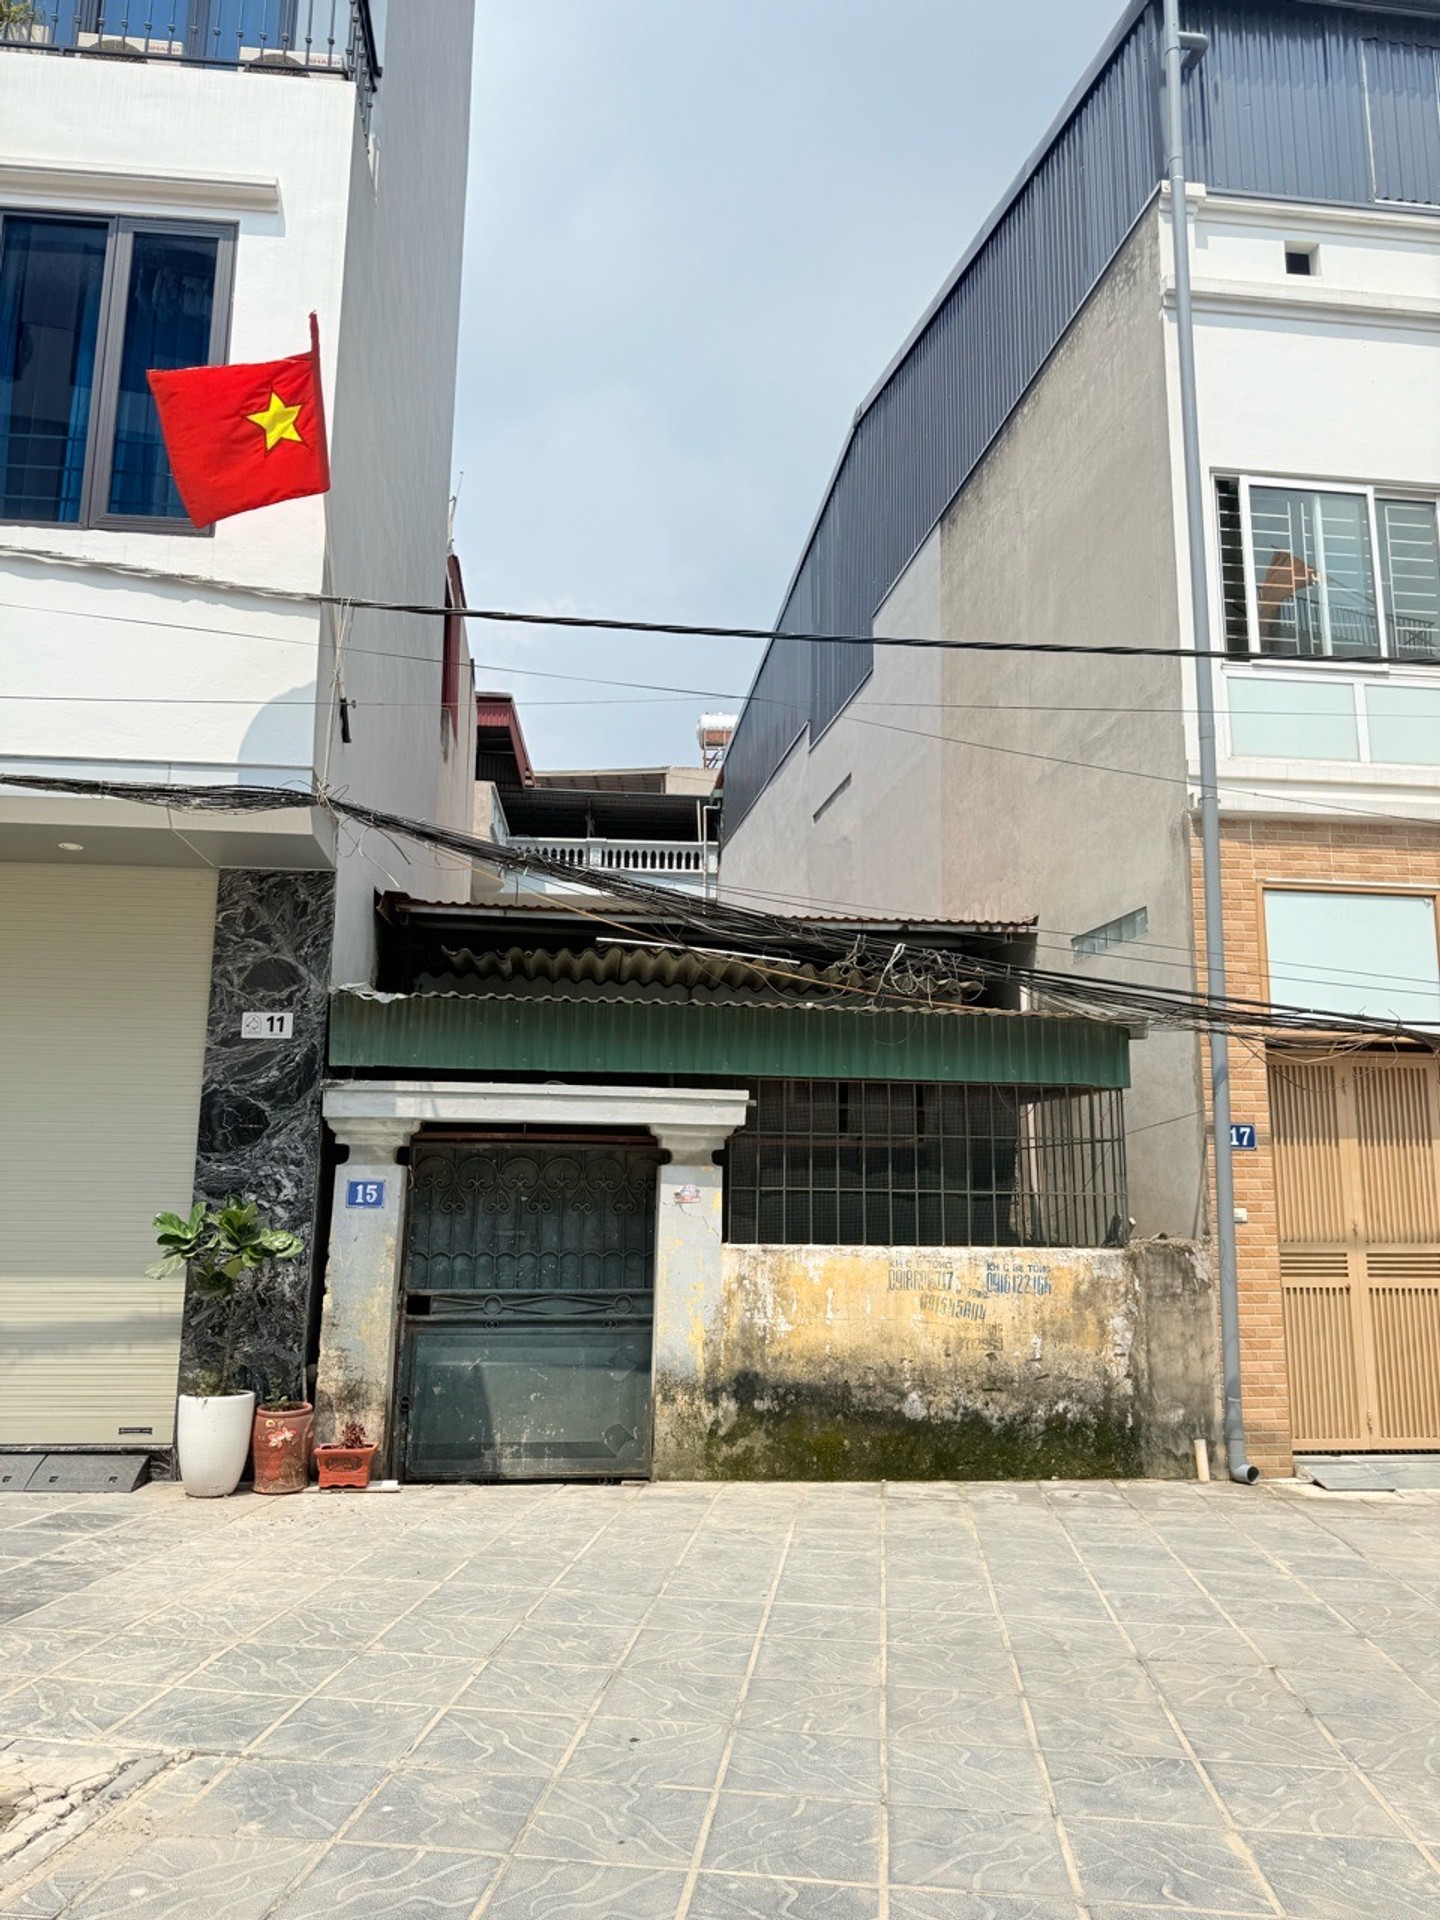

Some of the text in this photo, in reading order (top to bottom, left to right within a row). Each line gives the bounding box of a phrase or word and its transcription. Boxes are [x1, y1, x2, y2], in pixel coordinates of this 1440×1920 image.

[266, 1015, 285, 1033] 11
[1230, 1126, 1251, 1146] 17
[355, 1184, 378, 1203] 15
